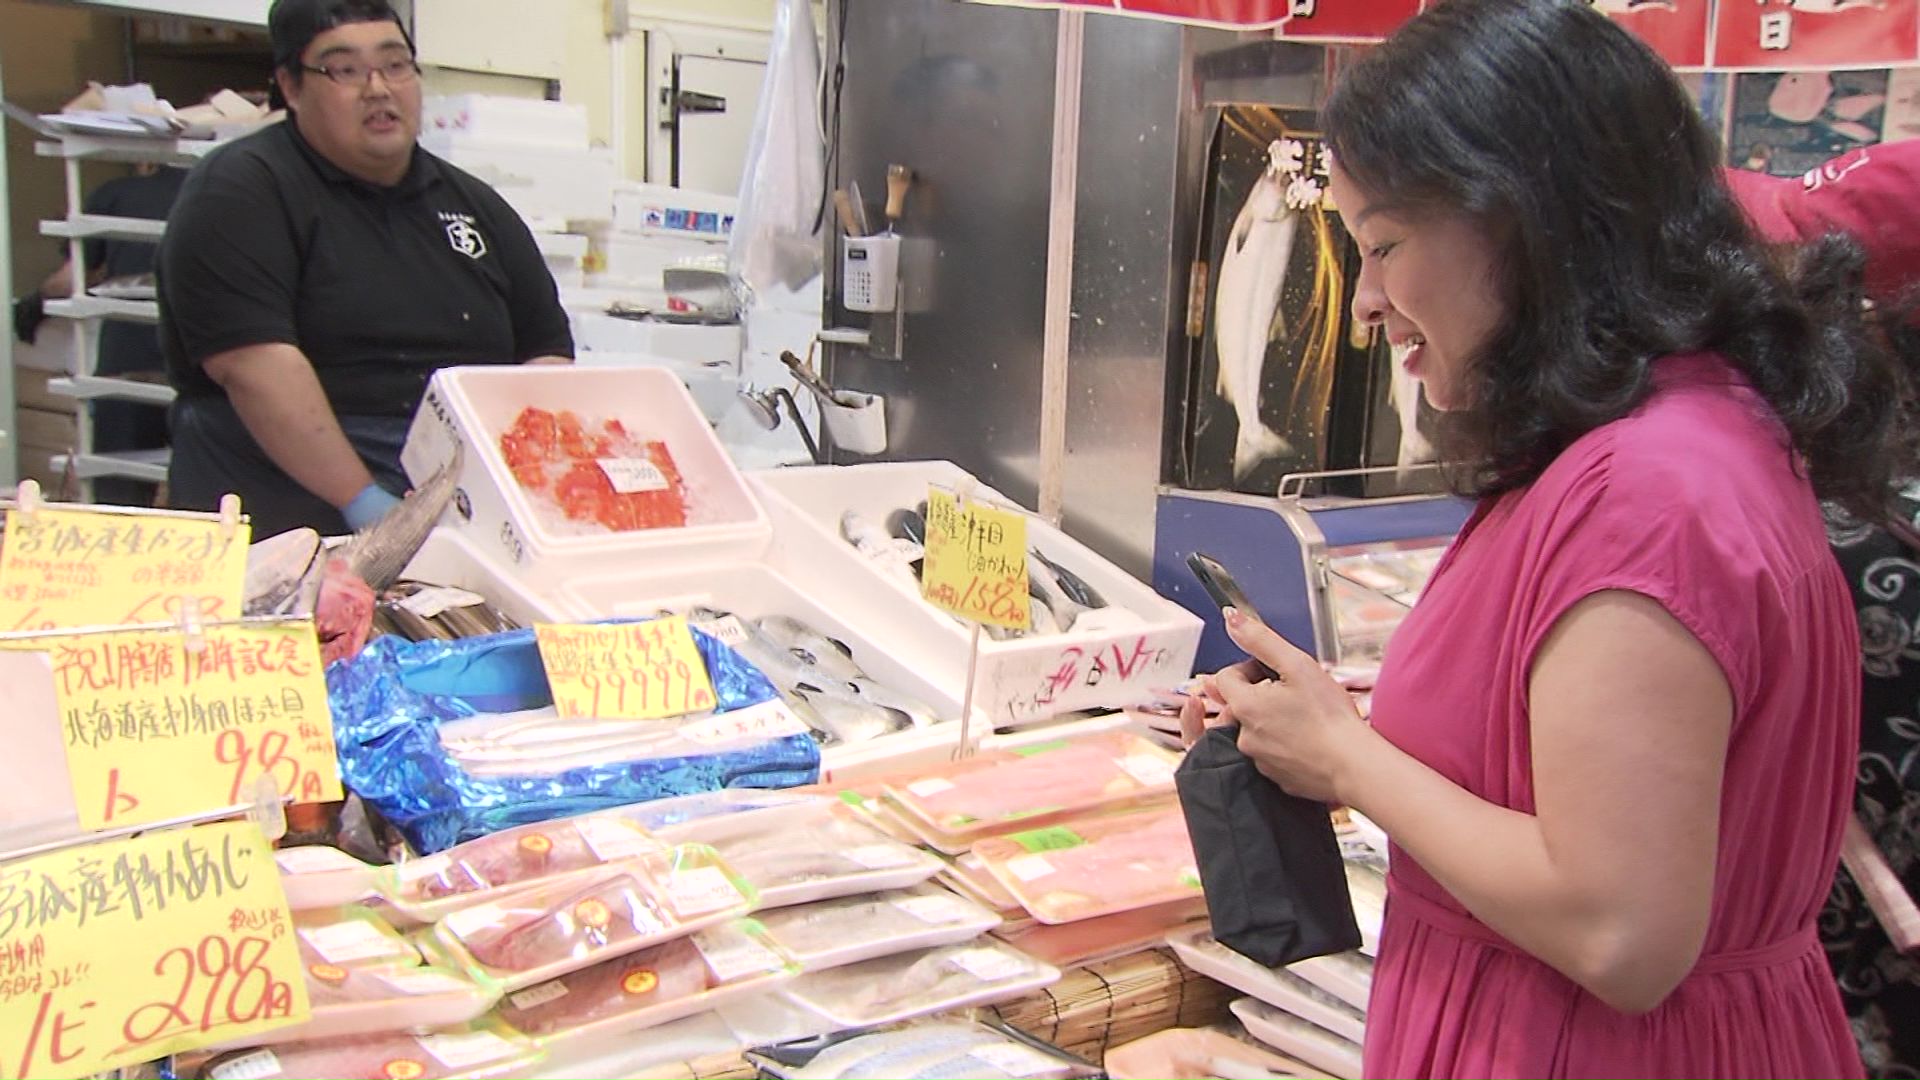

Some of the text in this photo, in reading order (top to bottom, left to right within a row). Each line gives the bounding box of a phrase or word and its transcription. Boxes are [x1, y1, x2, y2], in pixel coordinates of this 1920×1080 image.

[66, 687, 305, 748] 北海道産刺身用ほっき貝
[122, 934, 293, 1044] 298円
